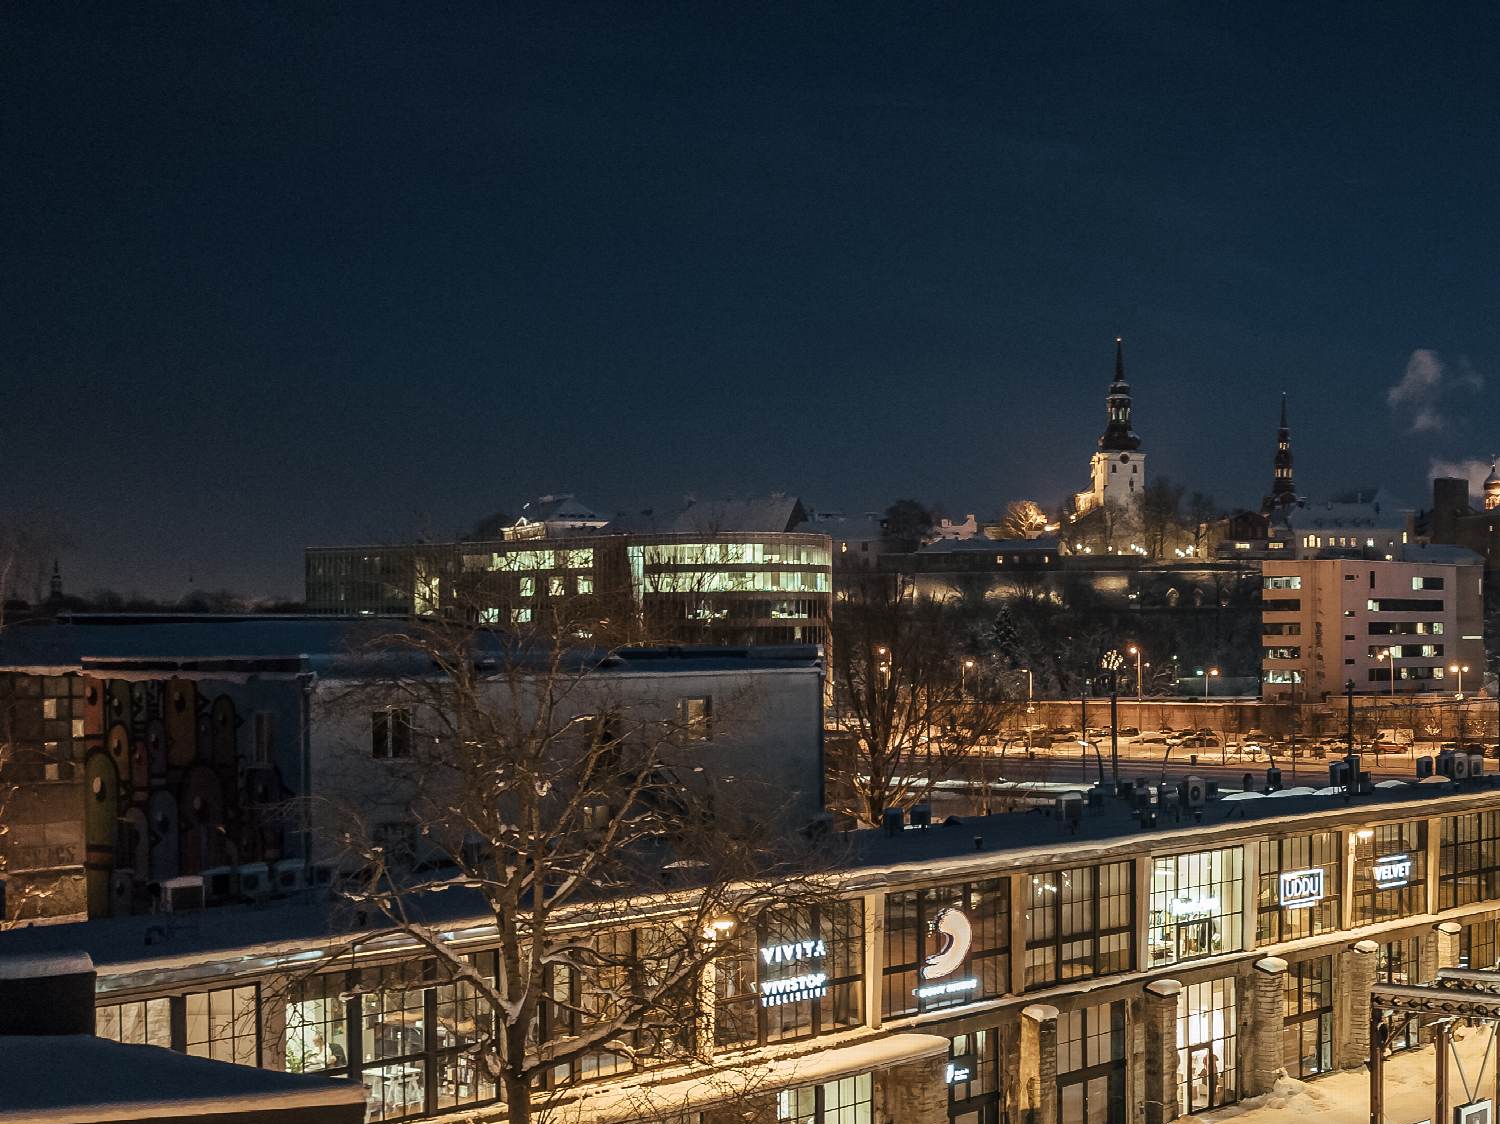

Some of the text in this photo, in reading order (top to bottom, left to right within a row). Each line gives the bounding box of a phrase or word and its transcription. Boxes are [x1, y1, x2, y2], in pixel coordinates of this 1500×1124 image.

[1373, 861, 1412, 880] VELVET
[1286, 876, 1319, 898] UDDU
[760, 940, 826, 964] VIVITA
[761, 973, 826, 995] VIVISTOP
